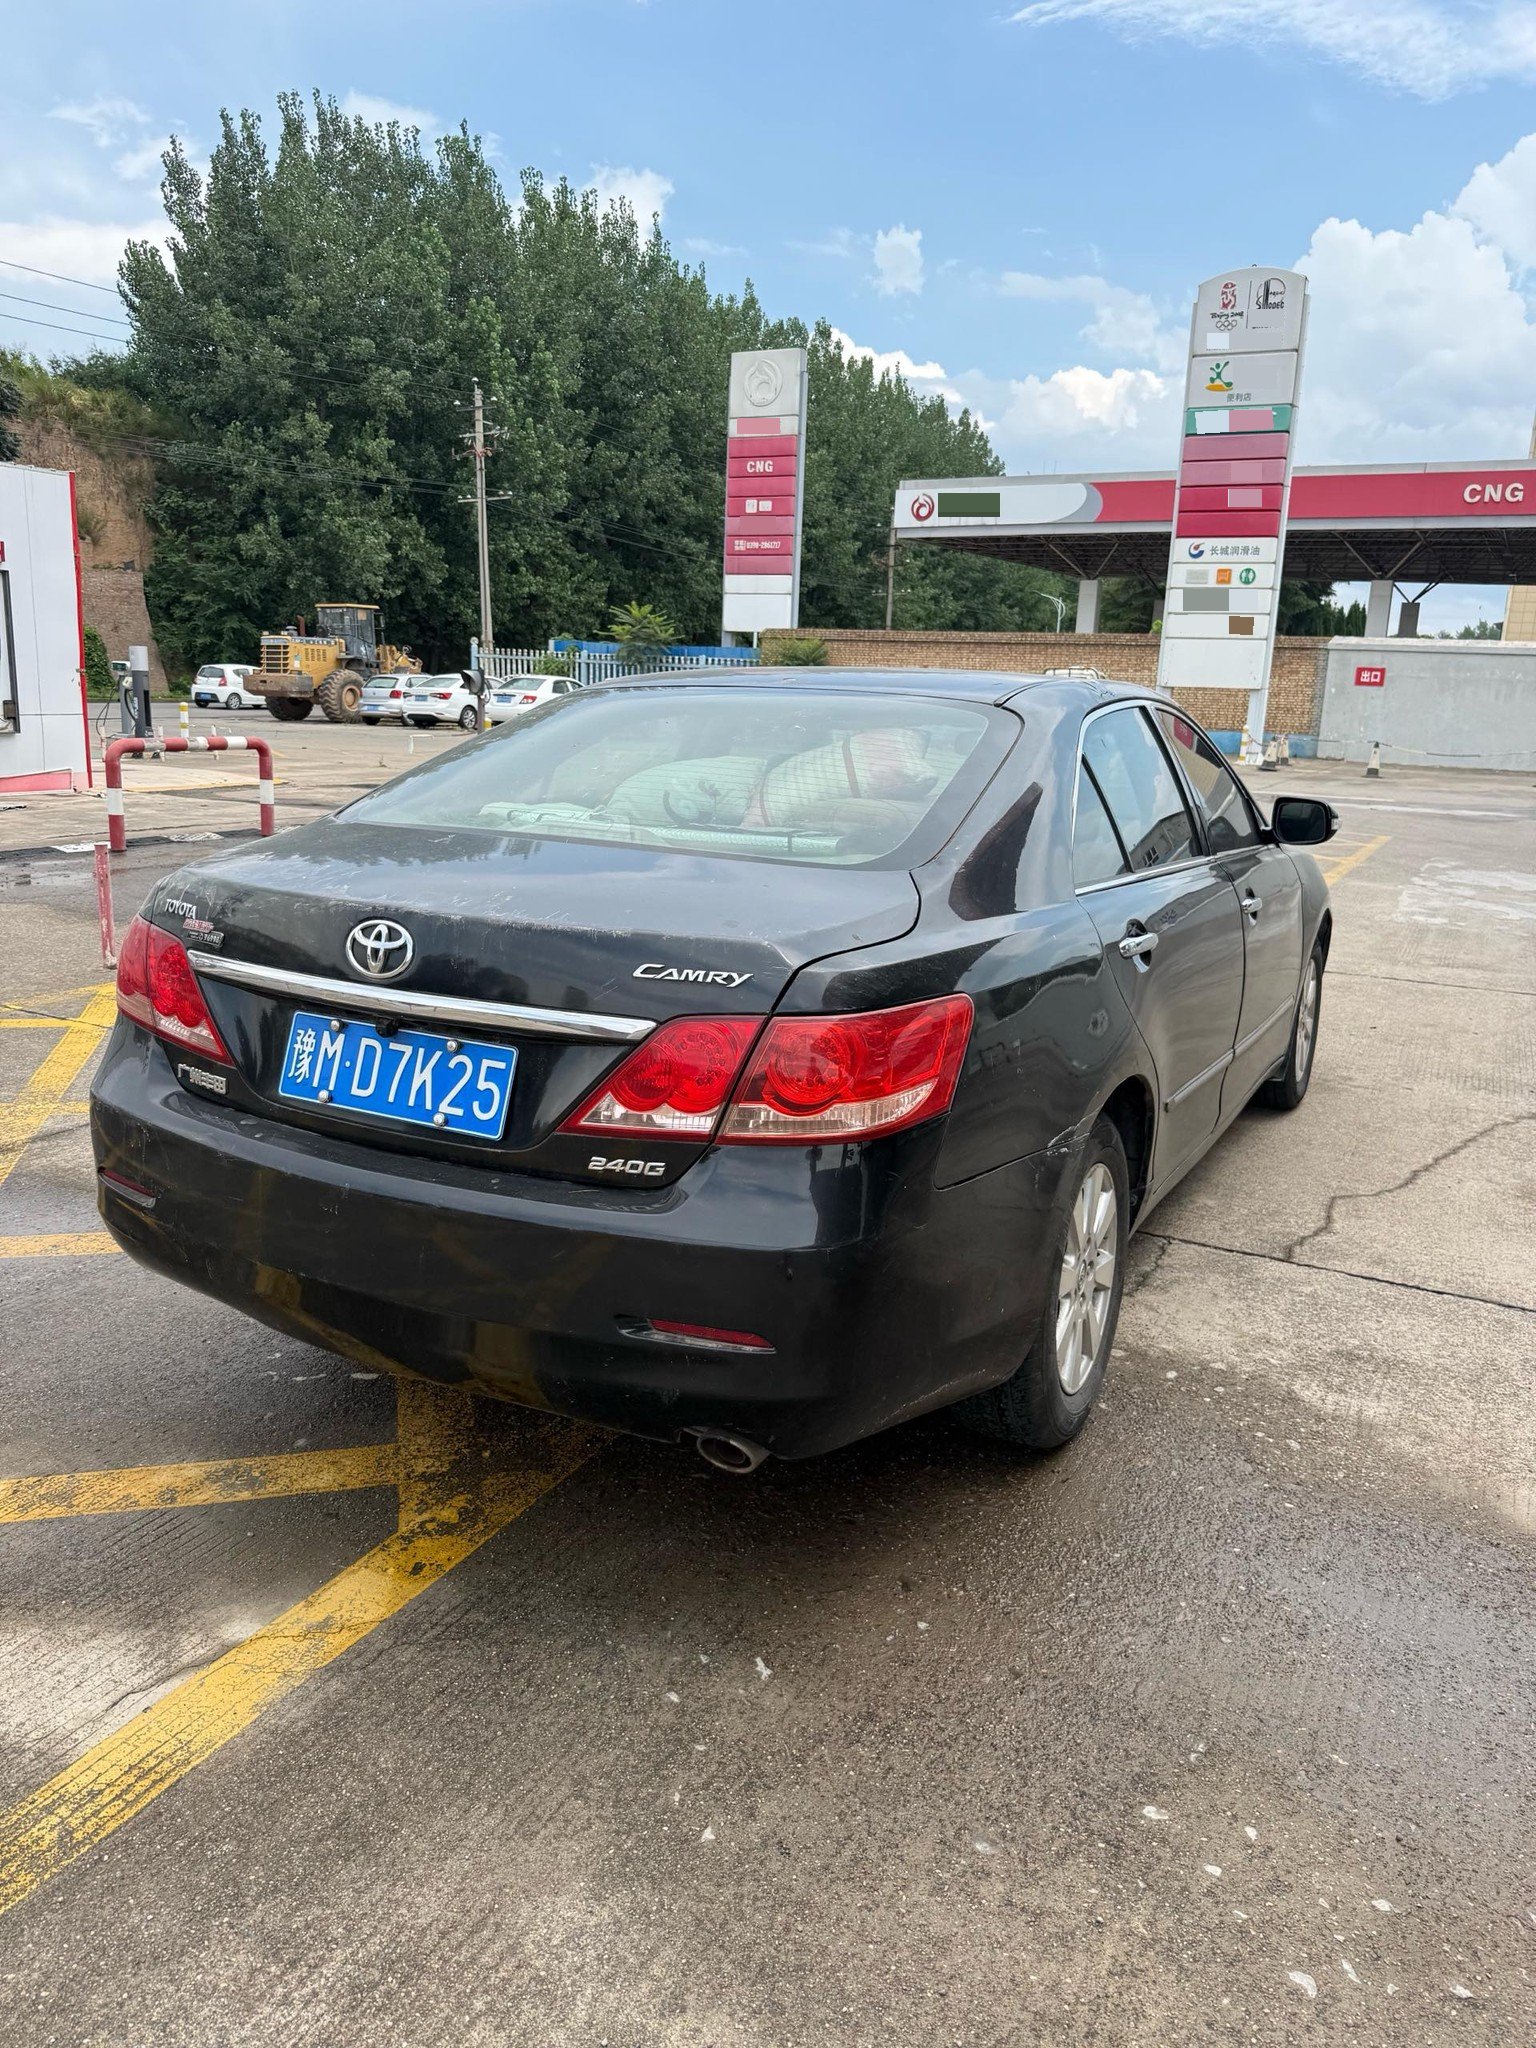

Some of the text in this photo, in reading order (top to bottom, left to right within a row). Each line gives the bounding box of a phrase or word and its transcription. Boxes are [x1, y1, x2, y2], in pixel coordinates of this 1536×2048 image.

[747, 460, 774, 473] CNG
[1463, 482, 1525, 503] CNG
[1210, 545, 1260, 556] 长城润滑油
[1360, 670, 1381, 683] 出口
[164, 898, 197, 920] TOYOTA
[632, 963, 754, 988] CAMRY
[587, 1156, 667, 1177] 240G
